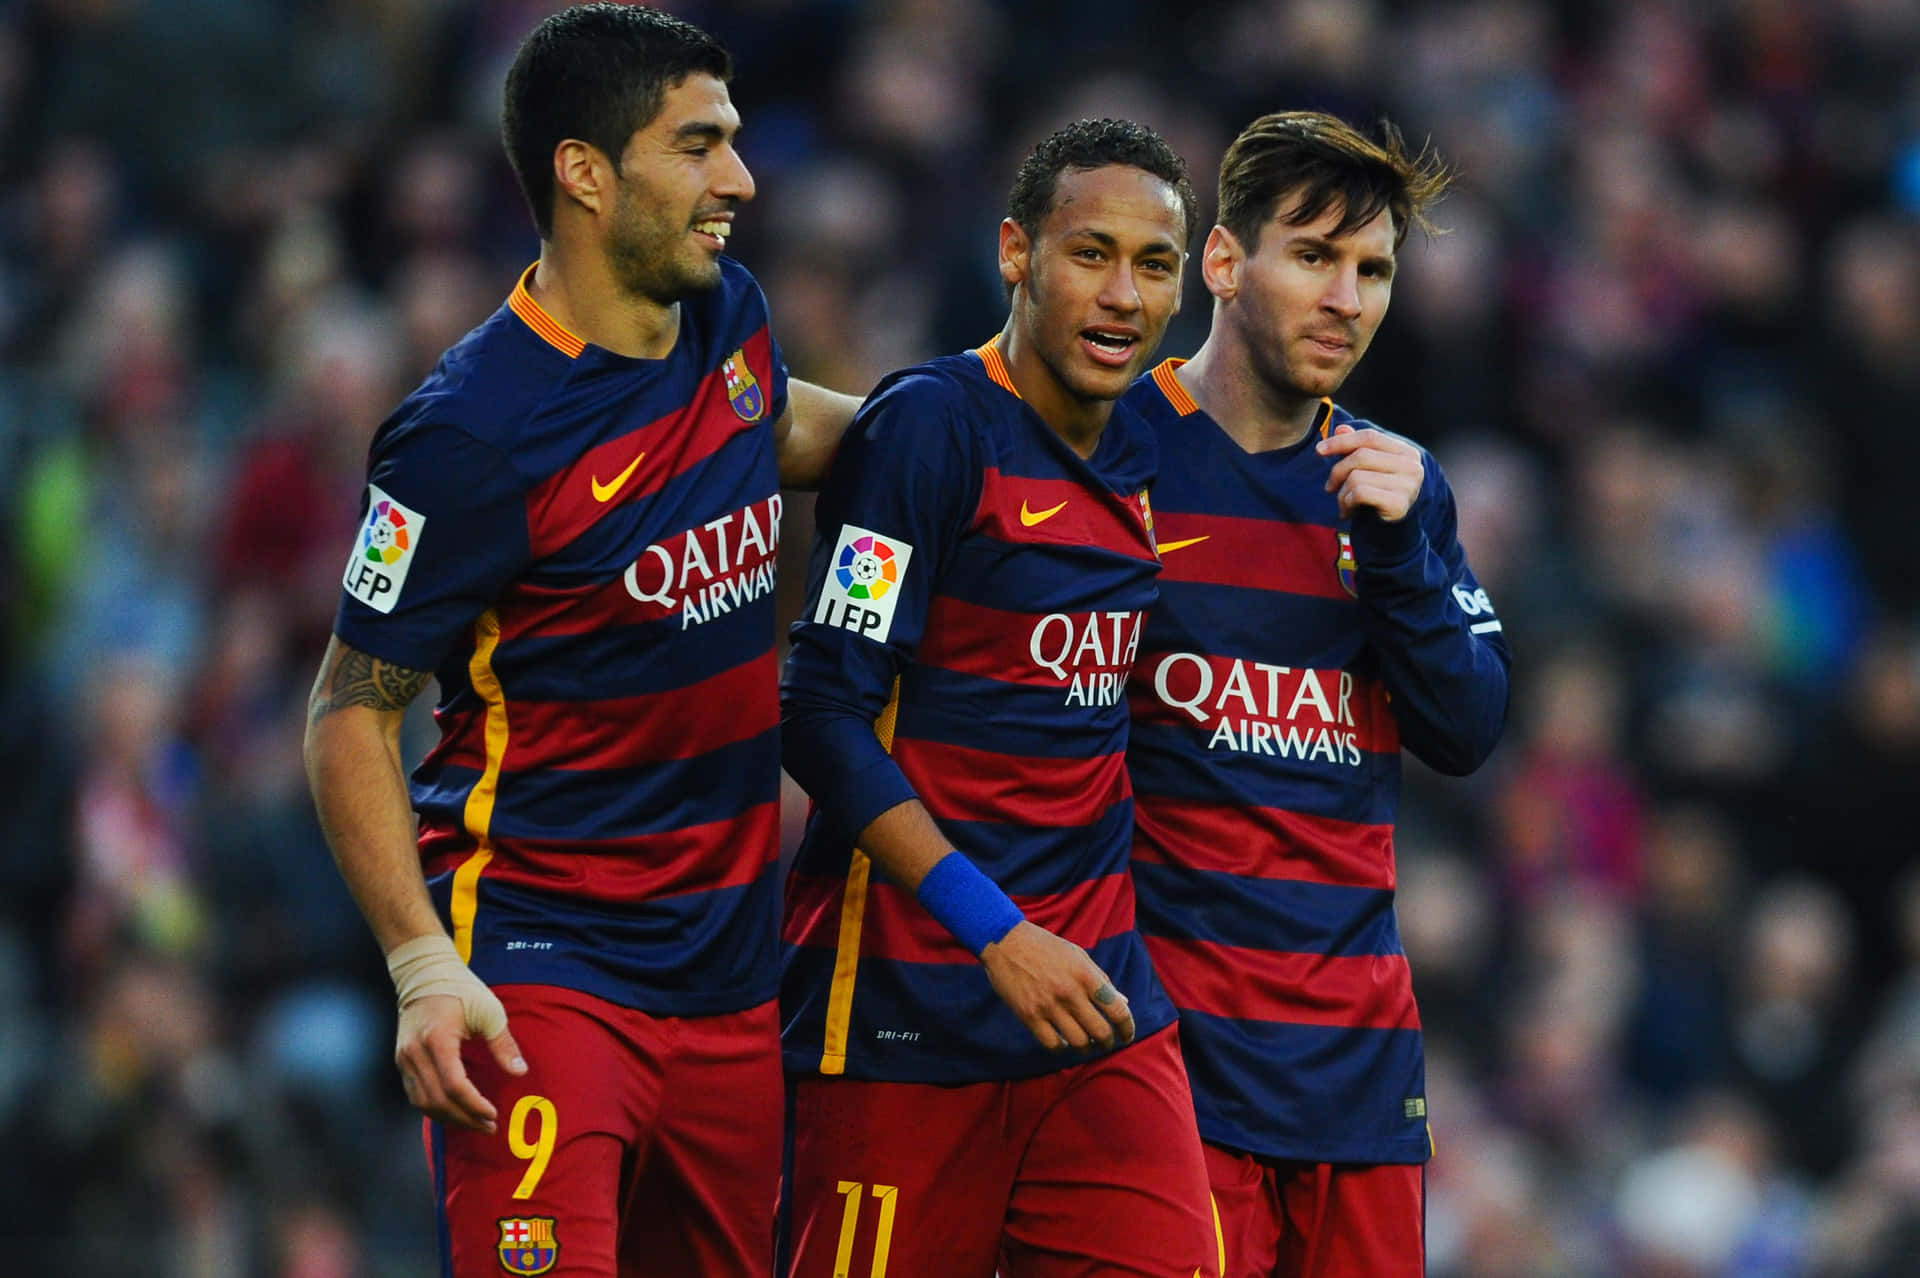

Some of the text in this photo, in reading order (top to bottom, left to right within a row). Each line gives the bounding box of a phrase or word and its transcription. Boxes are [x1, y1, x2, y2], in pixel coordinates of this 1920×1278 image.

[346, 555, 392, 601] LFP
[623, 493, 783, 609] QATAR
[680, 555, 777, 631] AIRWAY
[1452, 584, 1495, 616] be
[1030, 610, 1143, 681] QATA
[1064, 671, 1130, 707] AIRW
[1154, 652, 1355, 727] QATAR
[1208, 716, 1361, 767] AIRWAYS
[506, 941, 553, 951] DRI-FIT
[876, 1030, 920, 1041] DRI-FIT
[508, 1095, 558, 1199] 9
[833, 1180, 899, 1278] 11
